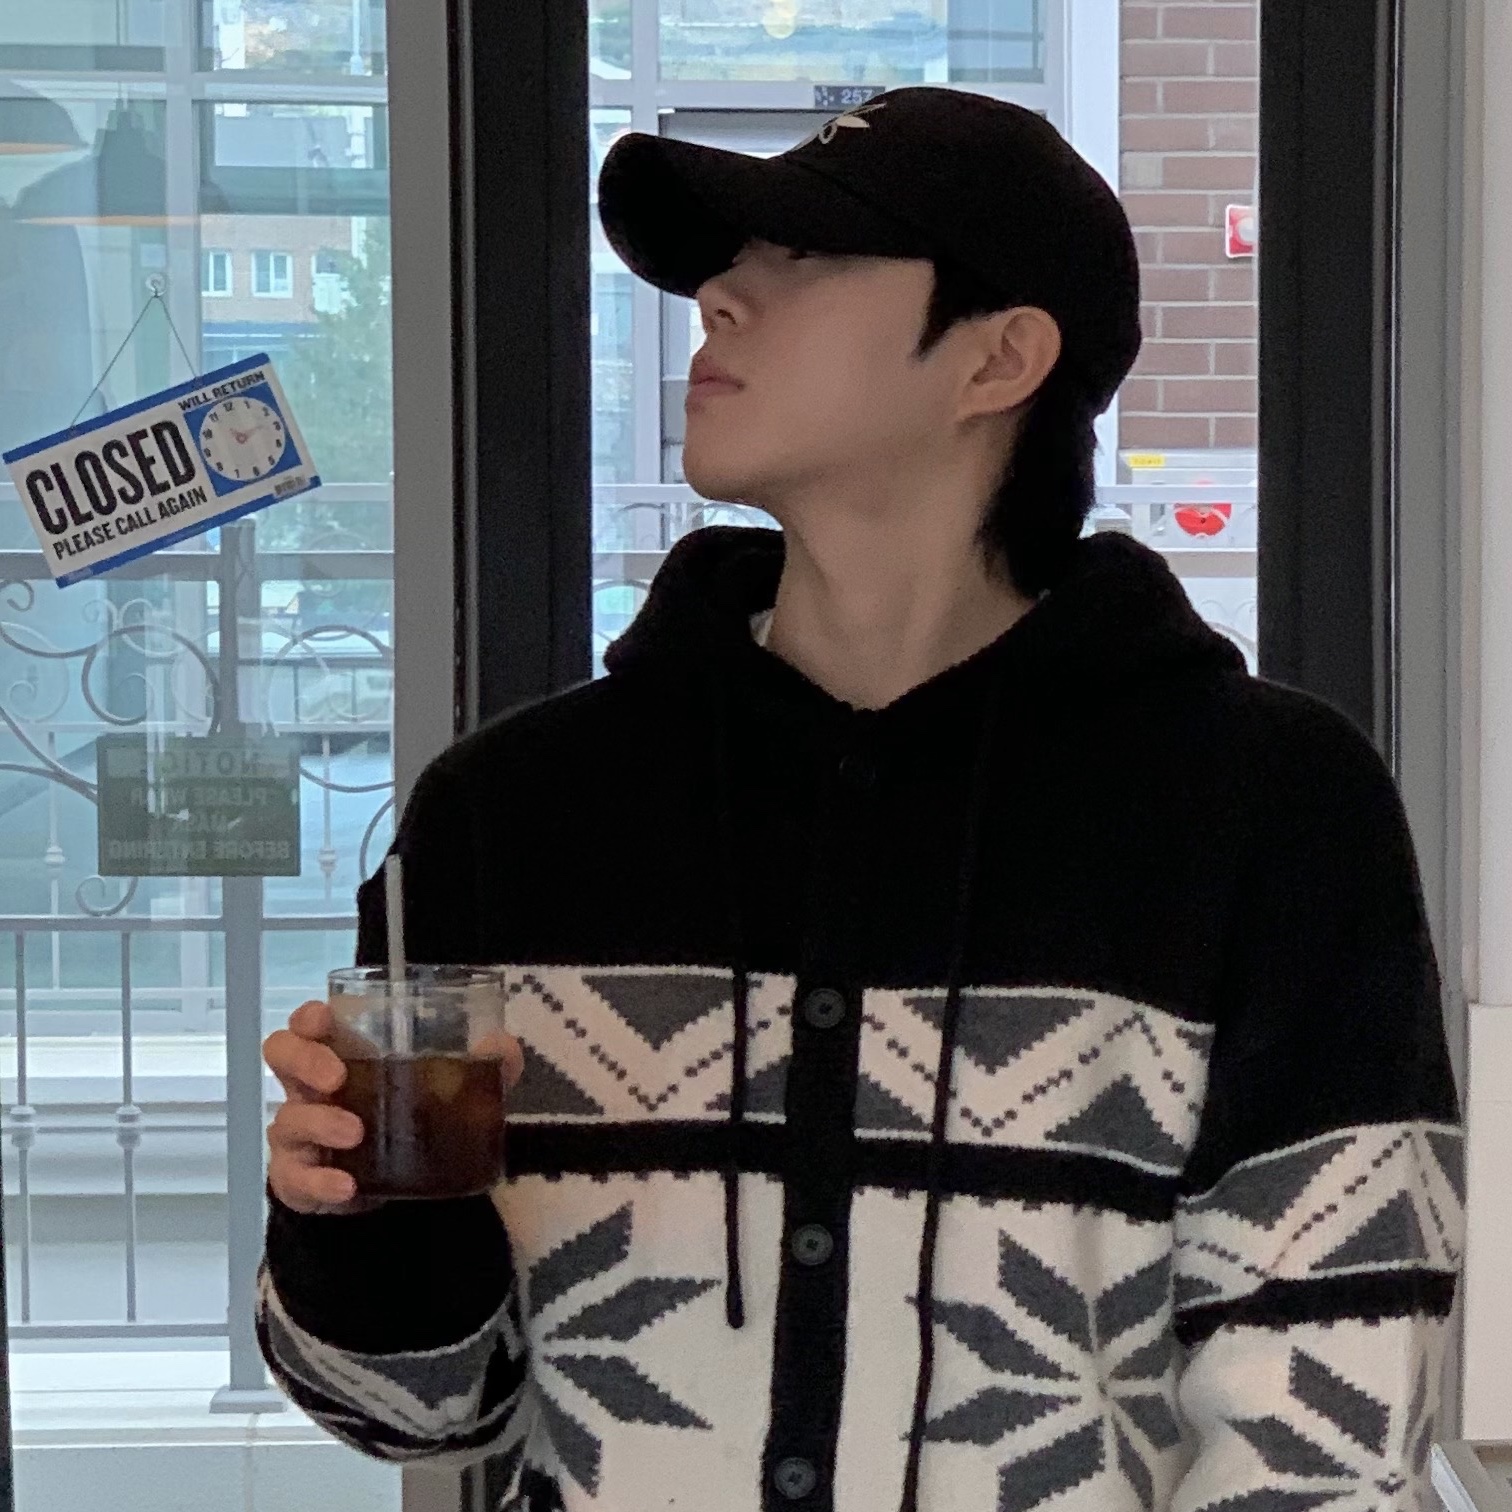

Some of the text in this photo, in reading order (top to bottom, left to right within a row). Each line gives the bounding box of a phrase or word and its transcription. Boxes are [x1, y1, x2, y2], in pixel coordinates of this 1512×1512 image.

[841, 88, 873, 104] 257
[178, 370, 265, 412] WILL RETURN
[25, 420, 196, 535] CLOSED
[52, 485, 208, 560] PLEASE CALL AGAIN
